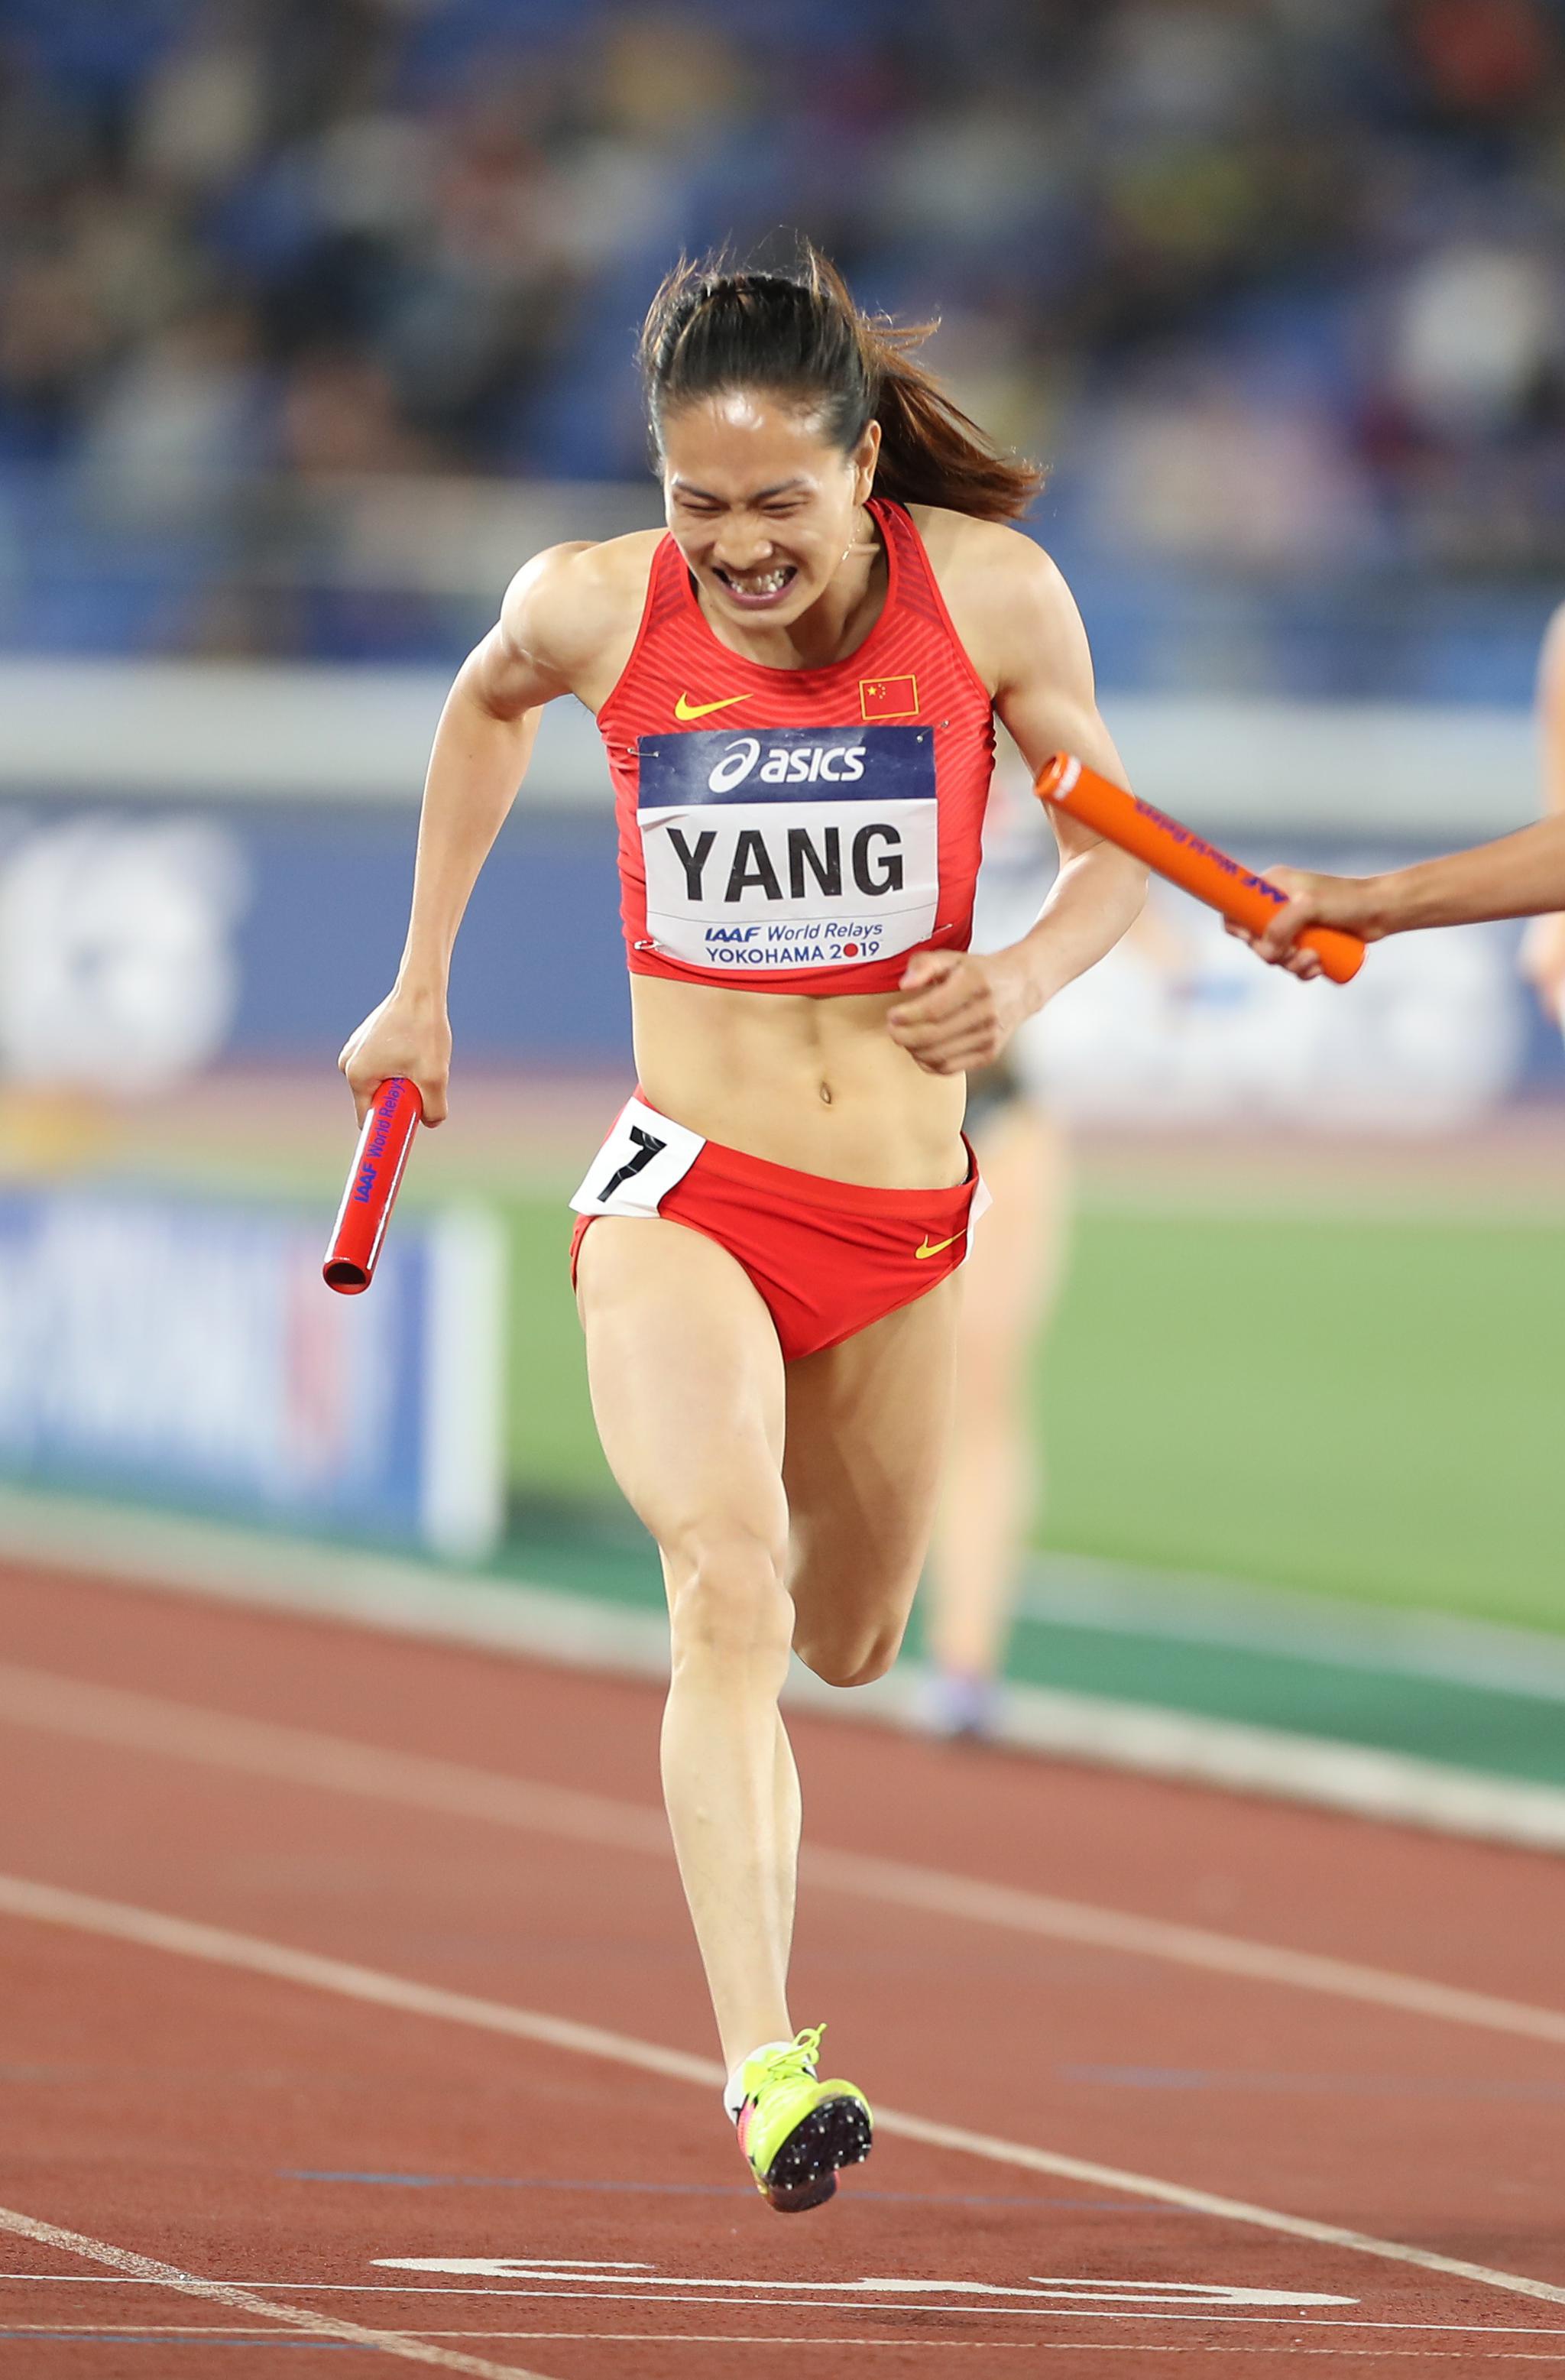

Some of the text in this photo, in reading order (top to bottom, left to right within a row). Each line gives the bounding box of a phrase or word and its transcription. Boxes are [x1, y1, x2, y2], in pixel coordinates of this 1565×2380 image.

[760, 747, 866, 783] asics
[666, 823, 903, 903] YANG
[1241, 875, 1290, 903] AAF
[705, 922, 883, 942] IAAF World Relays
[706, 945, 824, 964] YOKOHAMA
[354, 1162, 377, 1203] IAAF
[366, 1120, 391, 1159] World
[597, 1125, 667, 1203] 7
